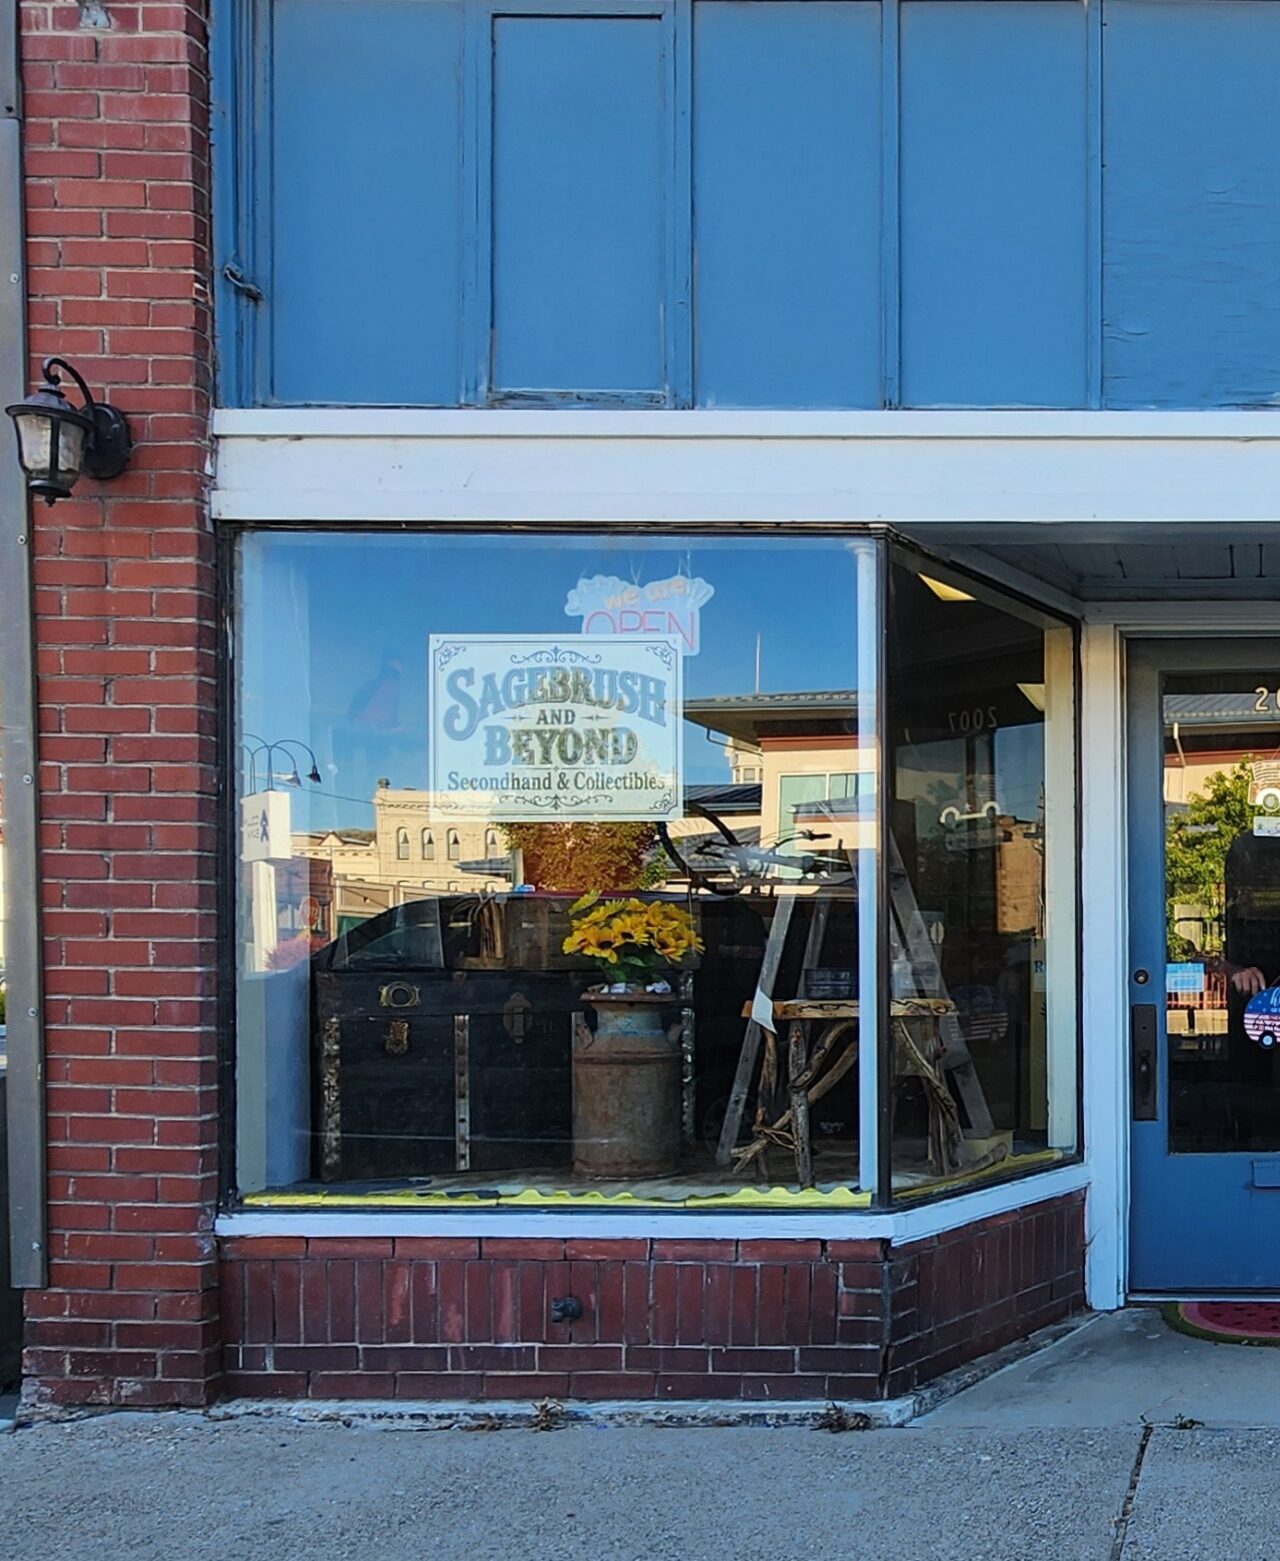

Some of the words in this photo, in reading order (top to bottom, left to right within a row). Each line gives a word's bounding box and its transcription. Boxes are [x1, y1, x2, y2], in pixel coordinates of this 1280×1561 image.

[585, 609, 696, 651] OPEN
[443, 666, 667, 741] SAGEBRUSH
[535, 709, 576, 725] AND
[483, 725, 638, 766] BEYOND
[448, 771, 552, 791] Secondhand
[557, 773, 570, 790] &
[574, 771, 665, 791] Collectibles
